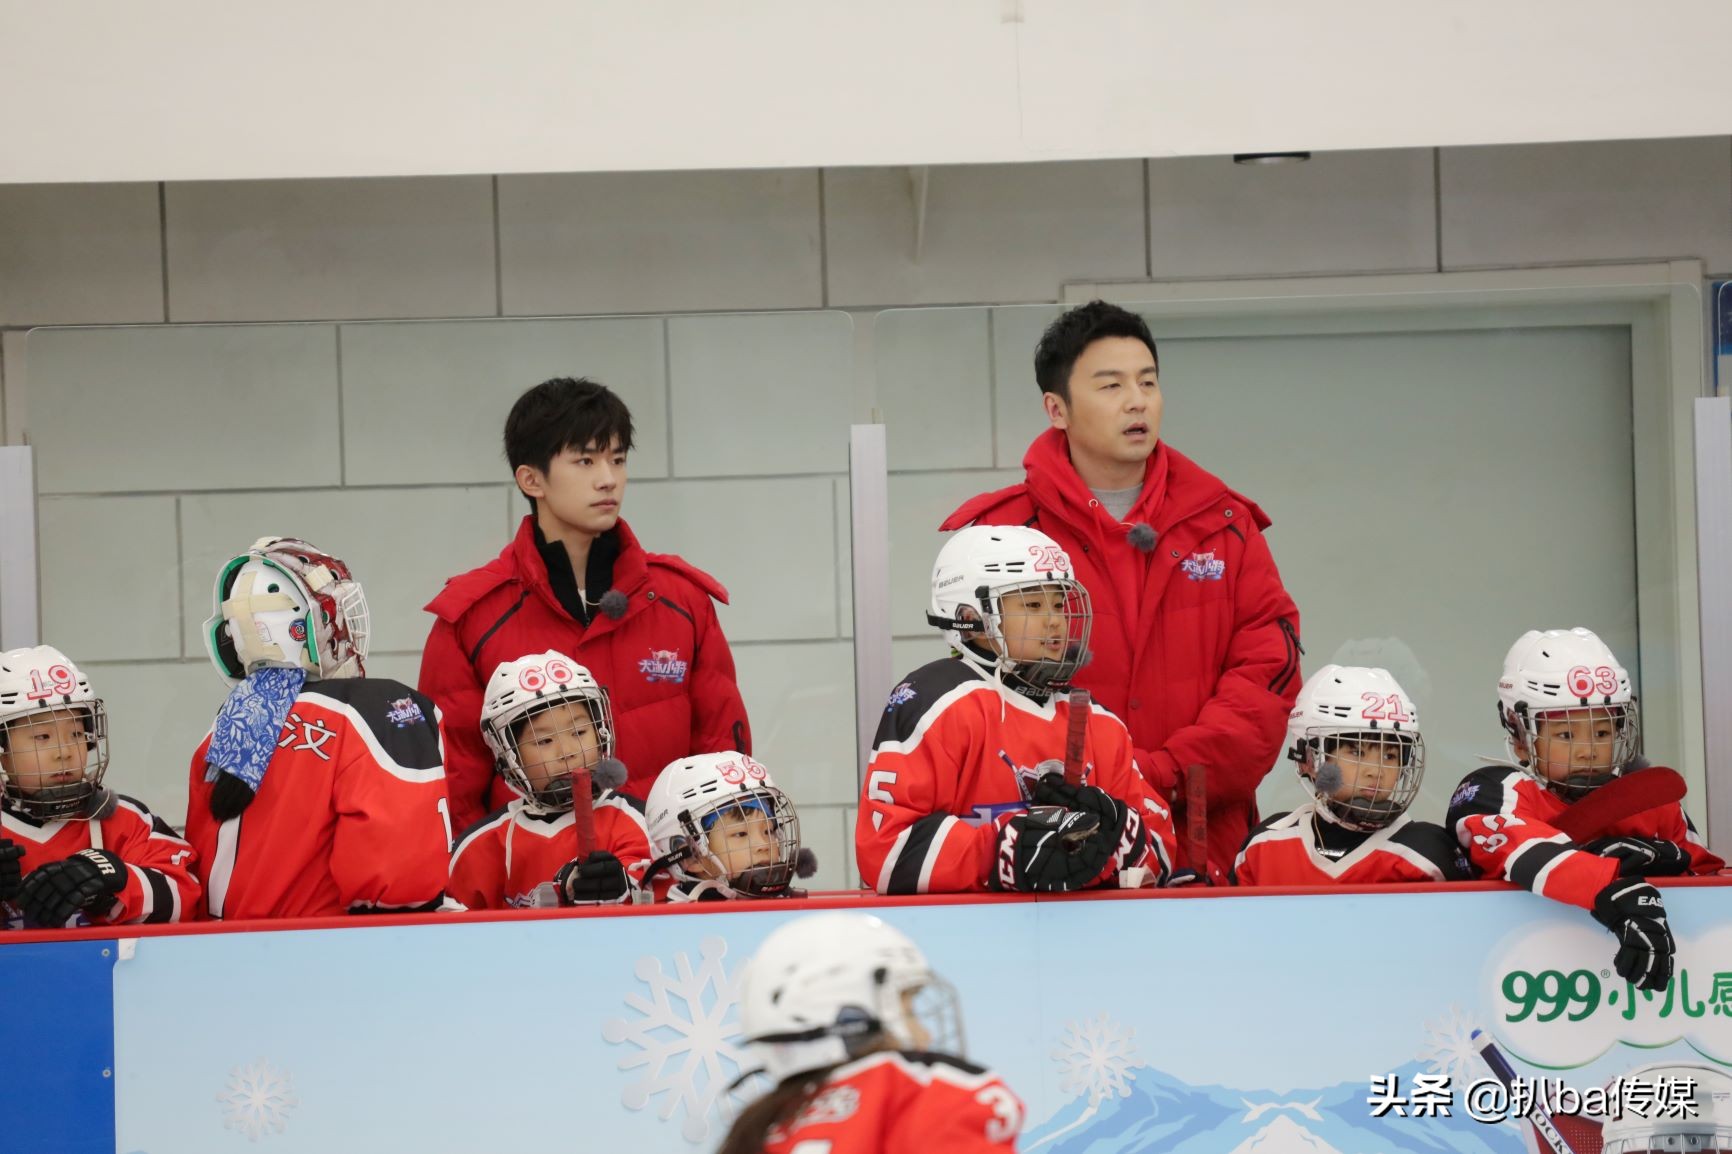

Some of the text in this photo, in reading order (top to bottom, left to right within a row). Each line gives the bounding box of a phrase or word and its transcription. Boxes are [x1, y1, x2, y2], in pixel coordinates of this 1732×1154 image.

[1028, 545, 1070, 573] 25
[938, 575, 964, 589] BAUER
[952, 622, 974, 630] BAUER
[26, 664, 77, 701] 19
[518, 659, 574, 693] 66
[1014, 685, 1053, 697] BAUE
[1567, 665, 1619, 698] 63
[1361, 691, 1410, 723] 21
[277, 712, 338, 761] 汶
[1112, 807, 1140, 872] CM
[1502, 969, 1602, 1023] 999
